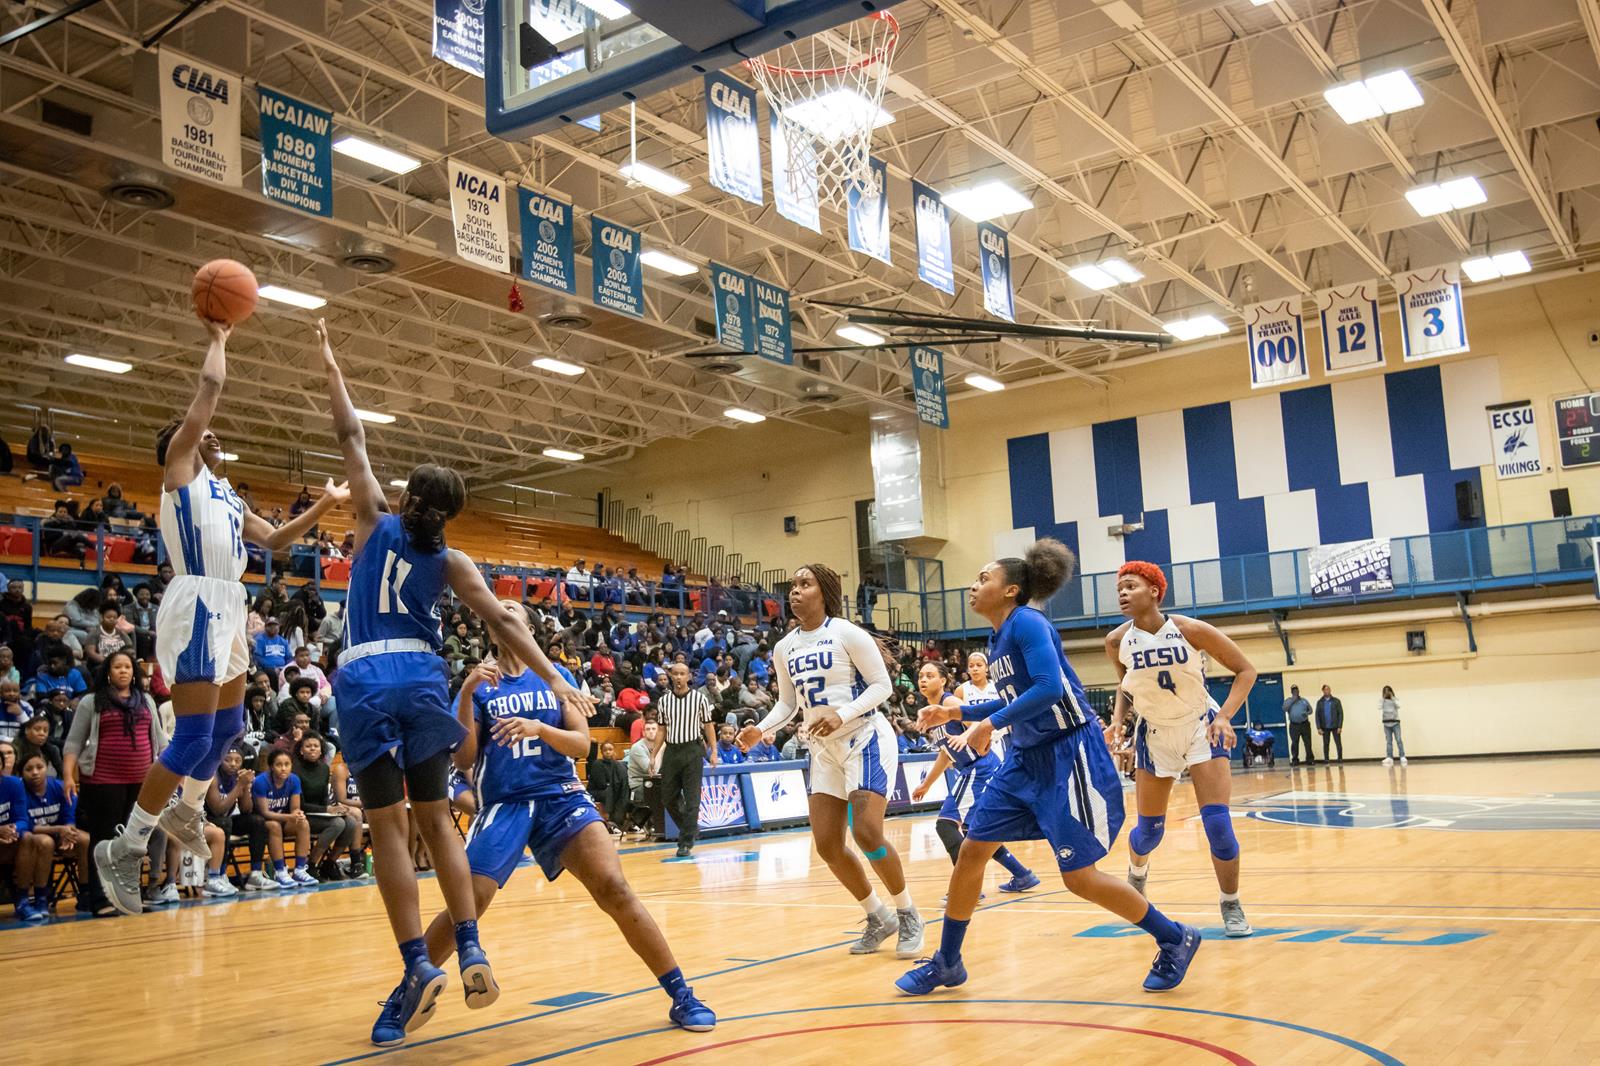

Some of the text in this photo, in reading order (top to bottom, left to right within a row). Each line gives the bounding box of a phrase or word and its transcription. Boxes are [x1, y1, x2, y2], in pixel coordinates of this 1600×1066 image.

[172, 63, 229, 105] CIAA
[711, 81, 752, 124] CIAA
[260, 95, 329, 136] NCAIAW
[183, 124, 214, 147] 1981
[276, 132, 316, 160] 1980
[170, 147, 227, 173] TOURNAMENT
[171, 137, 226, 163] BASKETBALL
[273, 150, 315, 172] WOMEN'S
[174, 158, 224, 182] CHAMPIONS
[265, 159, 323, 188] BASKETBALL
[281, 178, 298, 191] DIV.
[456, 171, 499, 203] NCAA
[268, 185, 321, 212] CHAMPIONS
[467, 198, 490, 216] 1978
[918, 194, 945, 217] CIAA
[466, 214, 492, 229] SOUTH
[529, 196, 564, 226] CIAA
[456, 229, 505, 254] BASKETBALL
[462, 223, 498, 242] ATLANTIC
[601, 226, 632, 254] CIAA
[981, 228, 1005, 258] CIAA
[459, 242, 504, 264] CHAMPIONS
[533, 252, 563, 269] WOMEN'S
[536, 240, 558, 258] 2002
[530, 270, 568, 290] CHAMPIONS
[532, 261, 566, 279] SOFTBALL
[607, 267, 627, 284] 2003
[598, 285, 626, 302] EASTERN
[604, 278, 631, 294] BOWLING
[718, 271, 745, 296] CIAA
[1410, 287, 1448, 301] ANTHONY
[601, 295, 636, 313] CHAMPIONS
[757, 284, 784, 307] NAIA
[1409, 294, 1451, 309] HILLIARD
[1338, 312, 1362, 323] GALE
[1339, 306, 1359, 316] MIKE
[1423, 307, 1445, 337] 3
[765, 324, 779, 338] 1972
[1257, 325, 1293, 339] TRAHAN
[1260, 319, 1289, 331] CELESTE
[1336, 321, 1366, 354] 12
[915, 348, 939, 374] CIAA
[1257, 335, 1297, 367] 00
[1560, 398, 1585, 410] HOME
[1492, 408, 1534, 430] ECSU
[1570, 437, 1590, 446] FOULS
[1581, 445, 1590, 457] 2
[1498, 460, 1541, 476] VIKINGS
[1310, 543, 1391, 588] ATHLETICS
[788, 651, 833, 677] ECSU
[1131, 646, 1188, 670] ECSU
[1157, 670, 1176, 695] 4
[487, 689, 558, 720] CHOWAN
